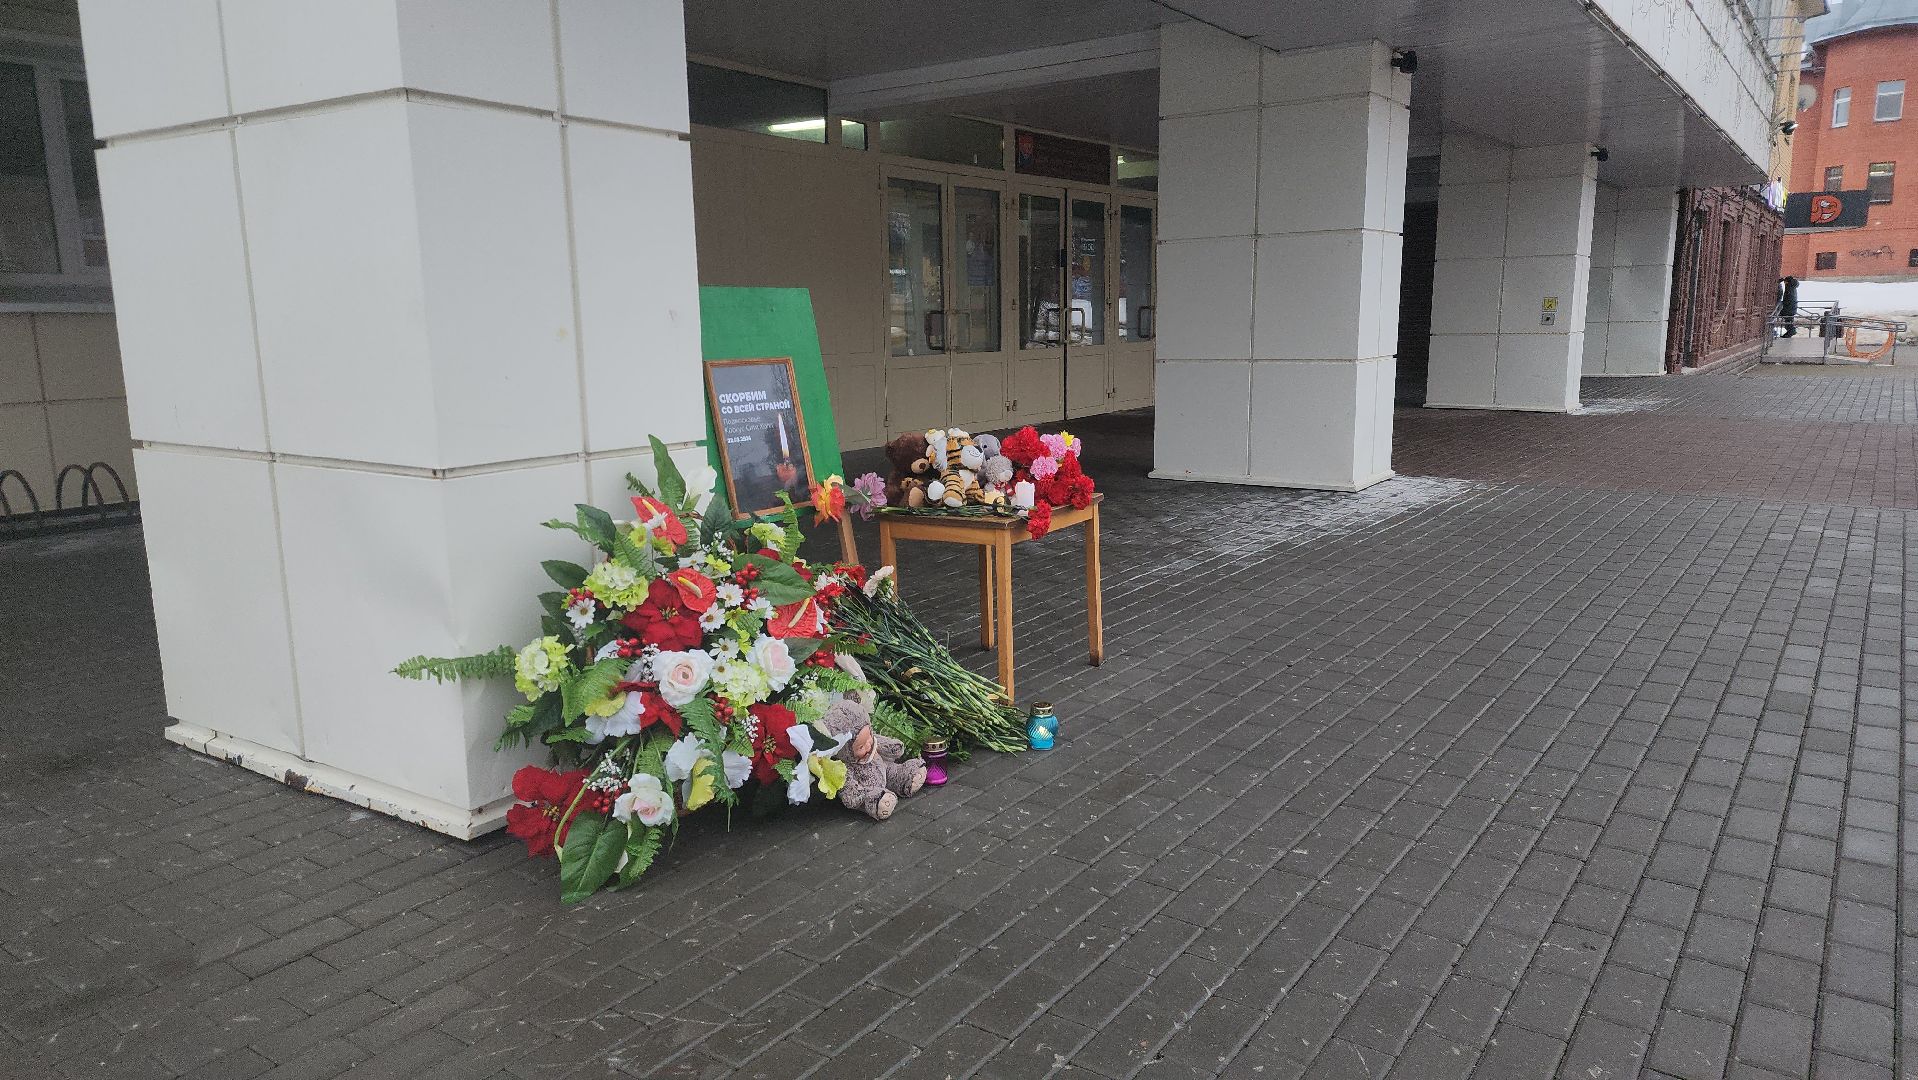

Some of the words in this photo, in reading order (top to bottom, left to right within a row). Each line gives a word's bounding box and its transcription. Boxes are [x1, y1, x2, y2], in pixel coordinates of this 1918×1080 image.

[719, 391, 767, 403] СКОРБИМ
[721, 406, 733, 414] СО
[734, 403, 755, 413] ВСЕЙ
[755, 400, 790, 411] СТРАНОЙ
